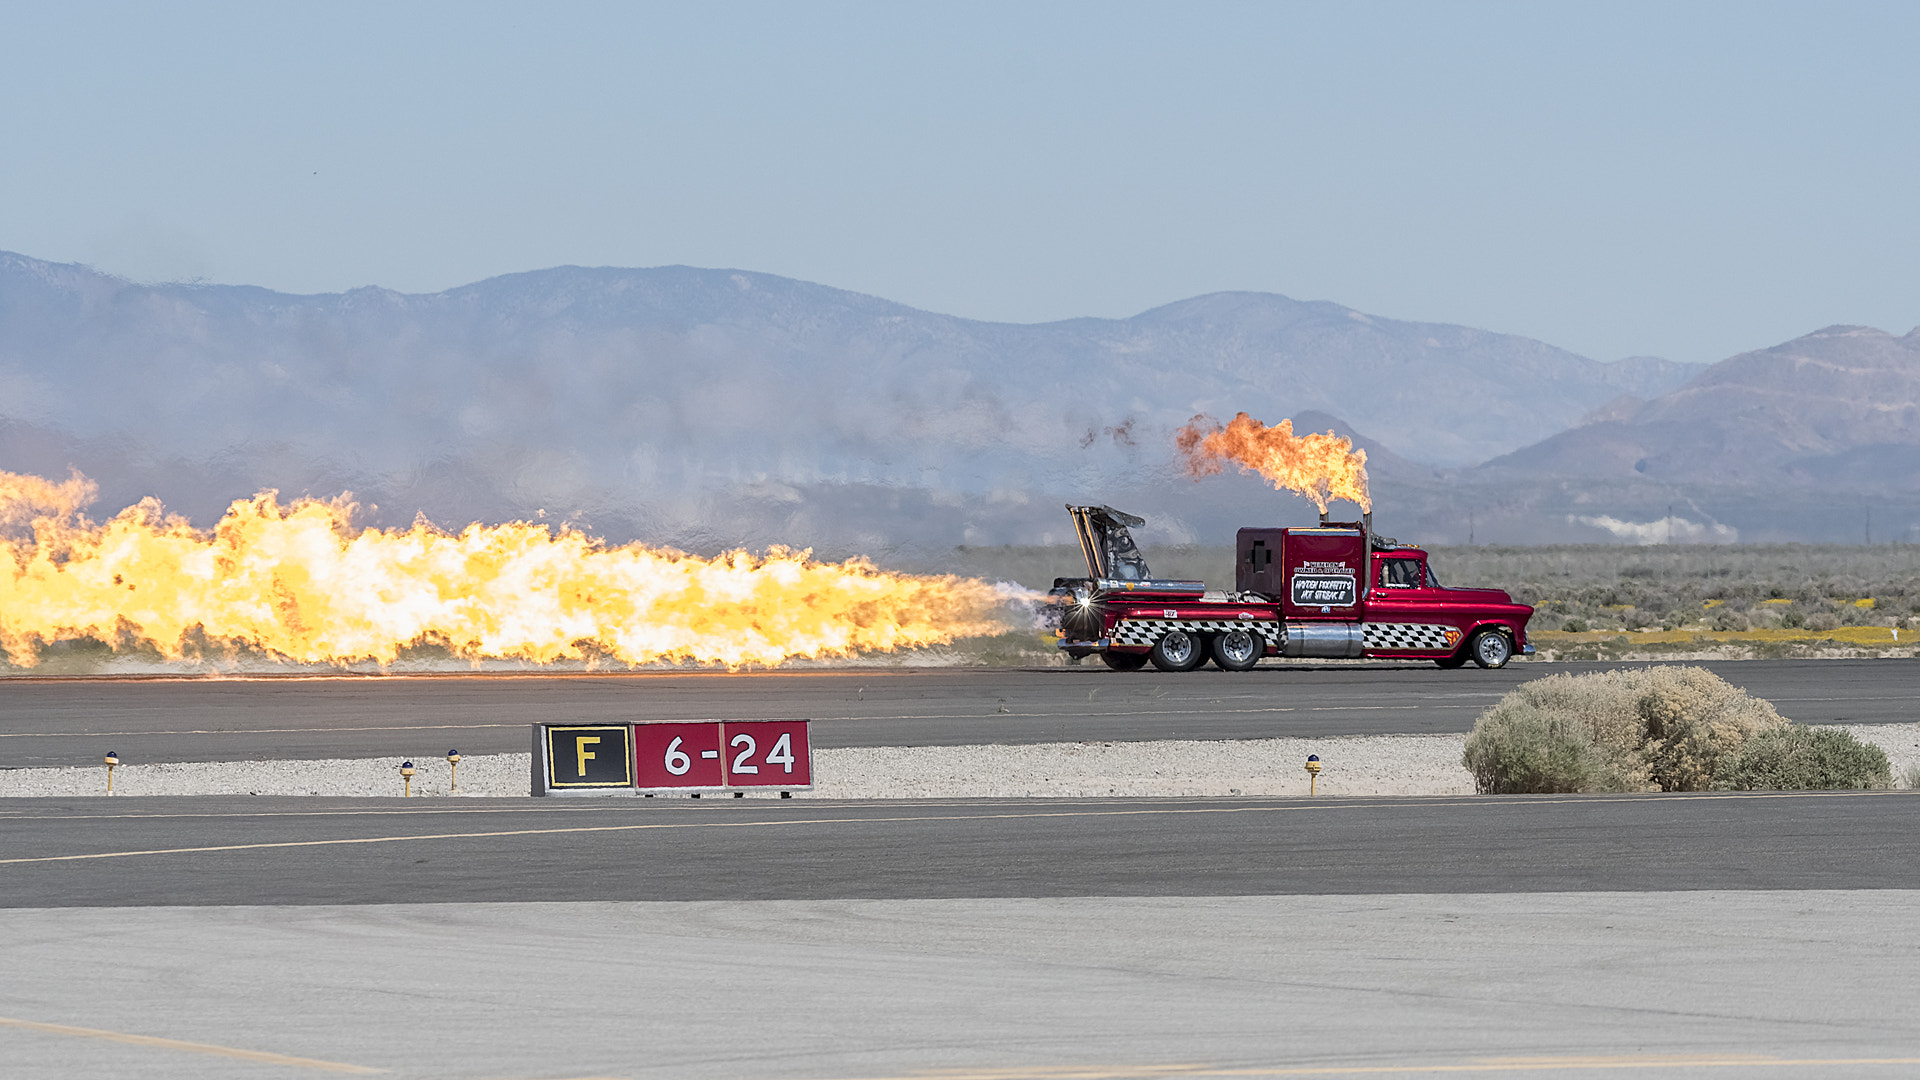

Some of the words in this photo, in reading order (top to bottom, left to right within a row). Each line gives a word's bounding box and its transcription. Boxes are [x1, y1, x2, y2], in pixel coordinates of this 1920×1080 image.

[1295, 580, 1318, 589] HAYDEN
[1301, 590, 1314, 599] HOT
[1315, 591, 1338, 600] STREAK
[576, 736, 601, 776] F
[664, 733, 795, 776] 6-24
